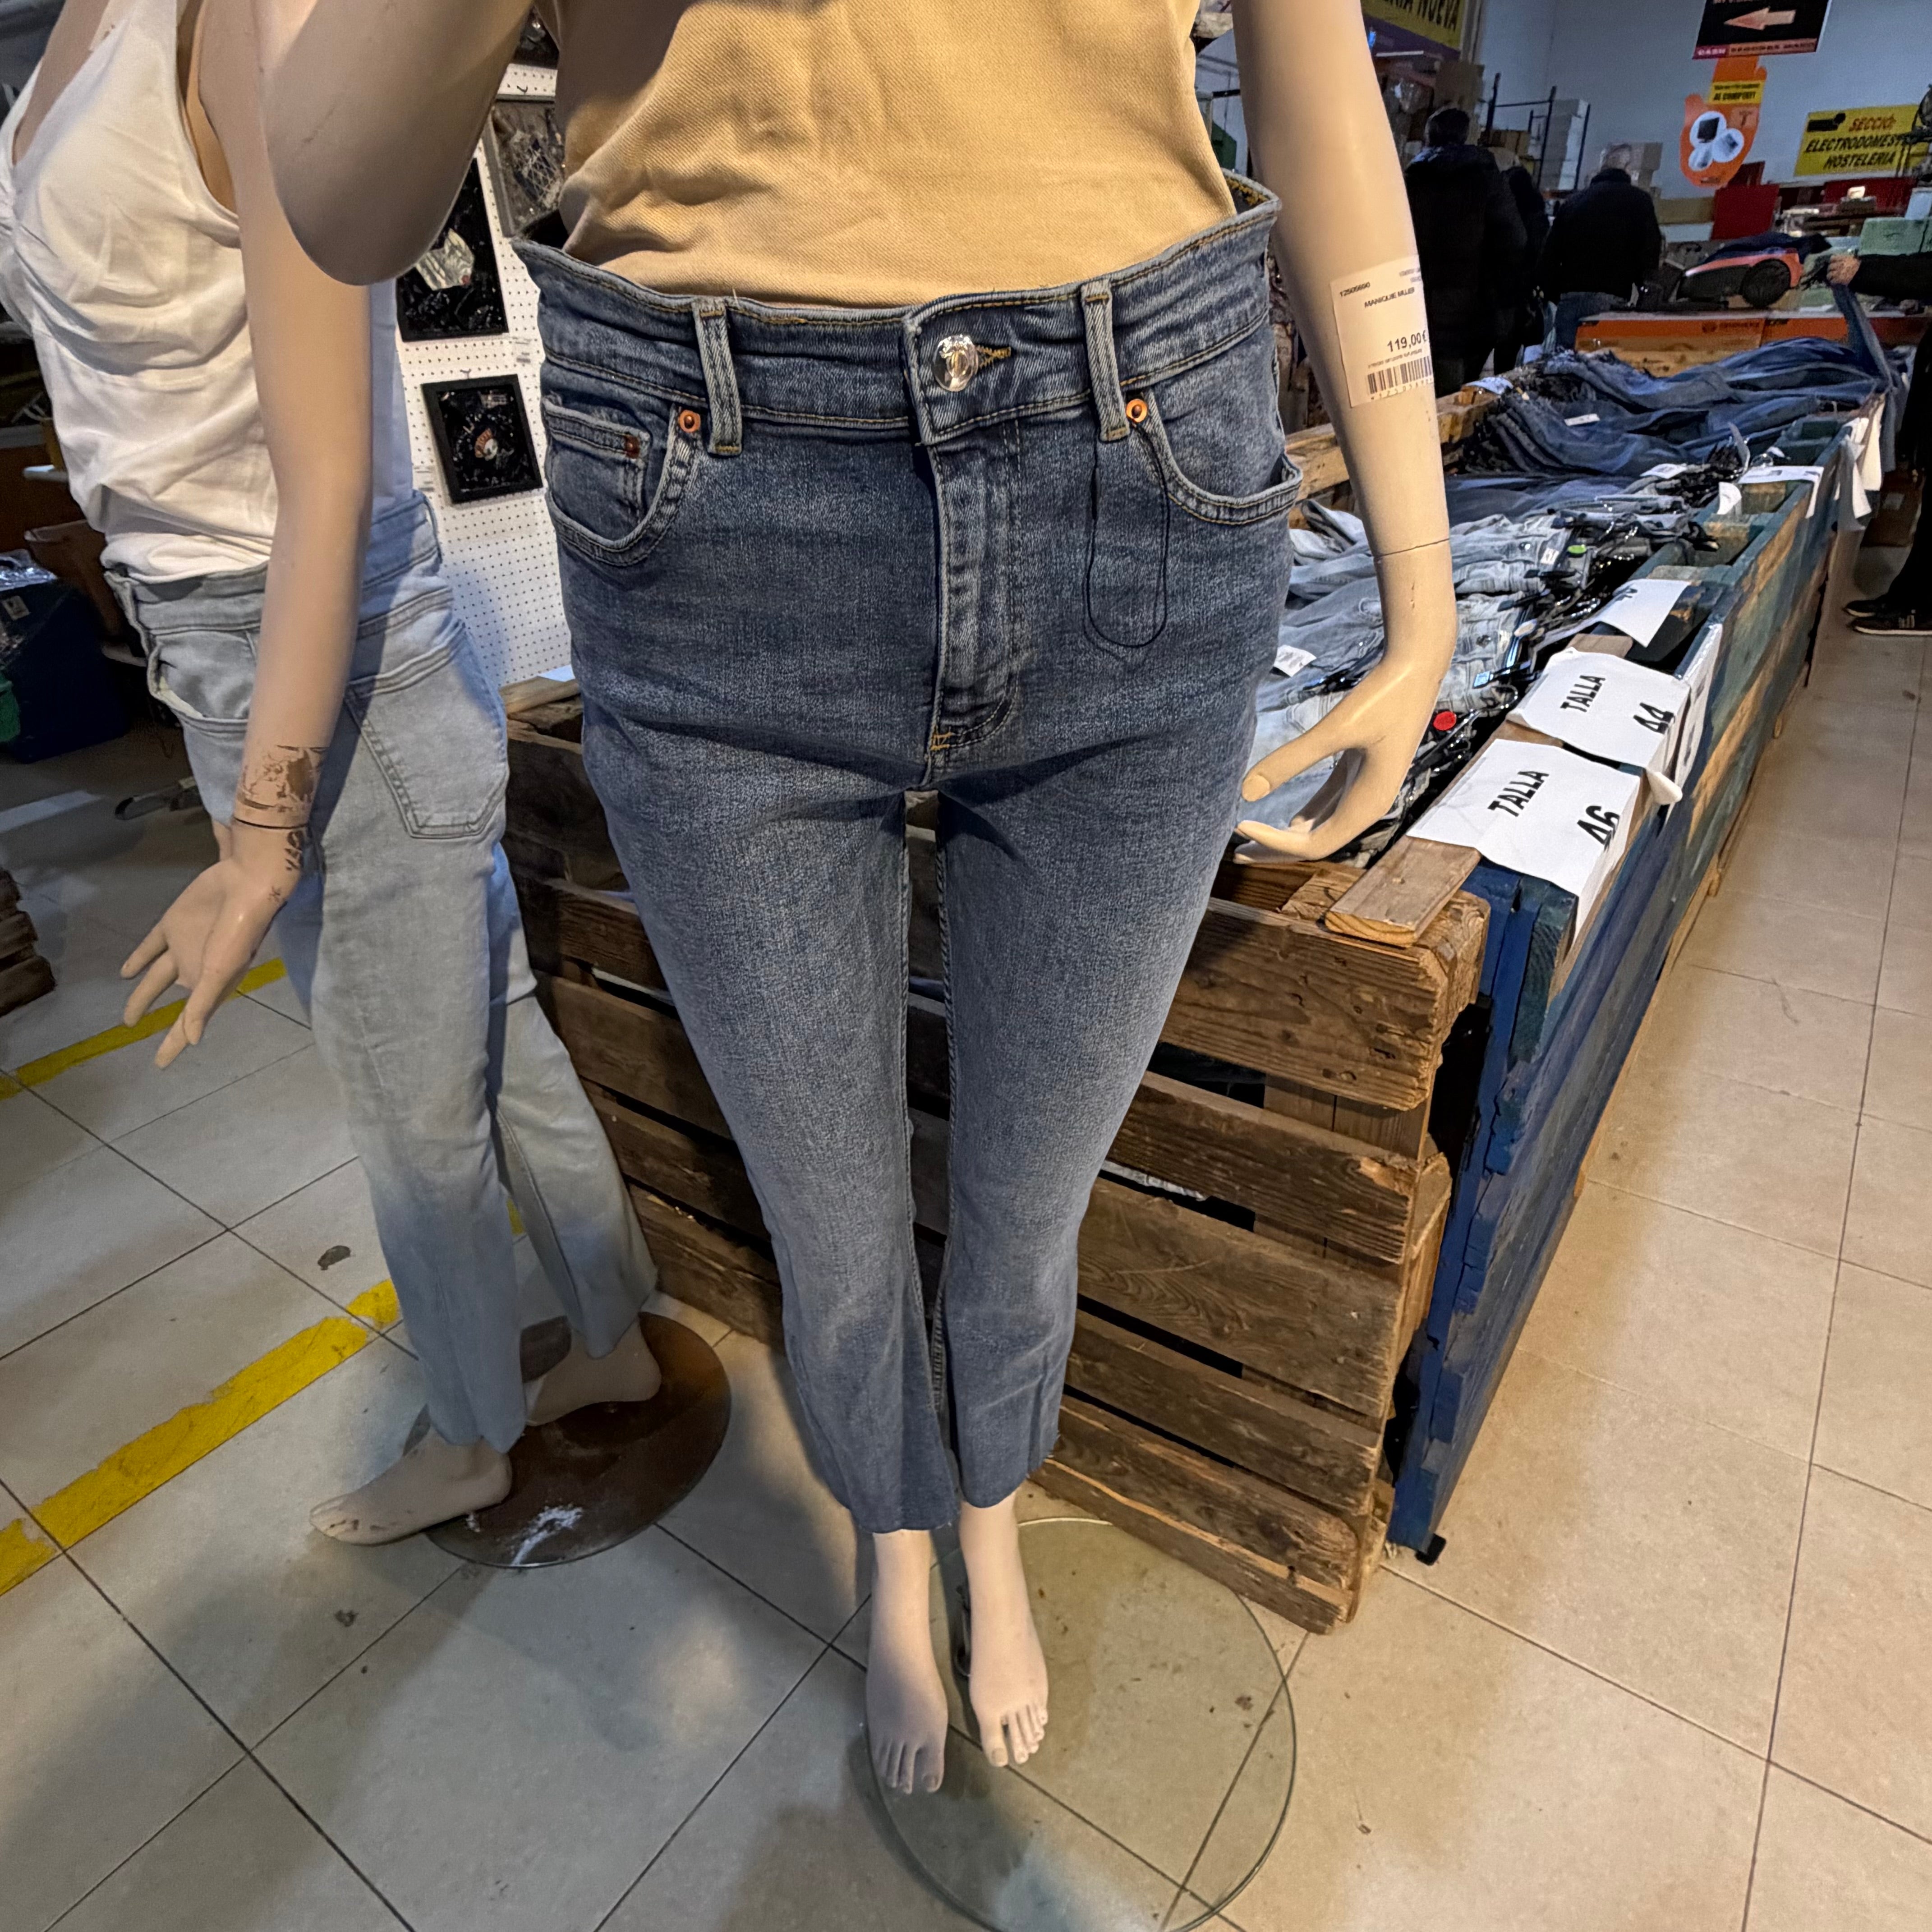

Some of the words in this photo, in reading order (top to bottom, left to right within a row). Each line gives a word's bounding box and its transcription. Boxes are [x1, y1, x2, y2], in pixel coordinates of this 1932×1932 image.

[1560, 675, 1606, 713] TALLA
[1487, 771, 1550, 817] TALLA
[1577, 805, 1620, 852] 46
